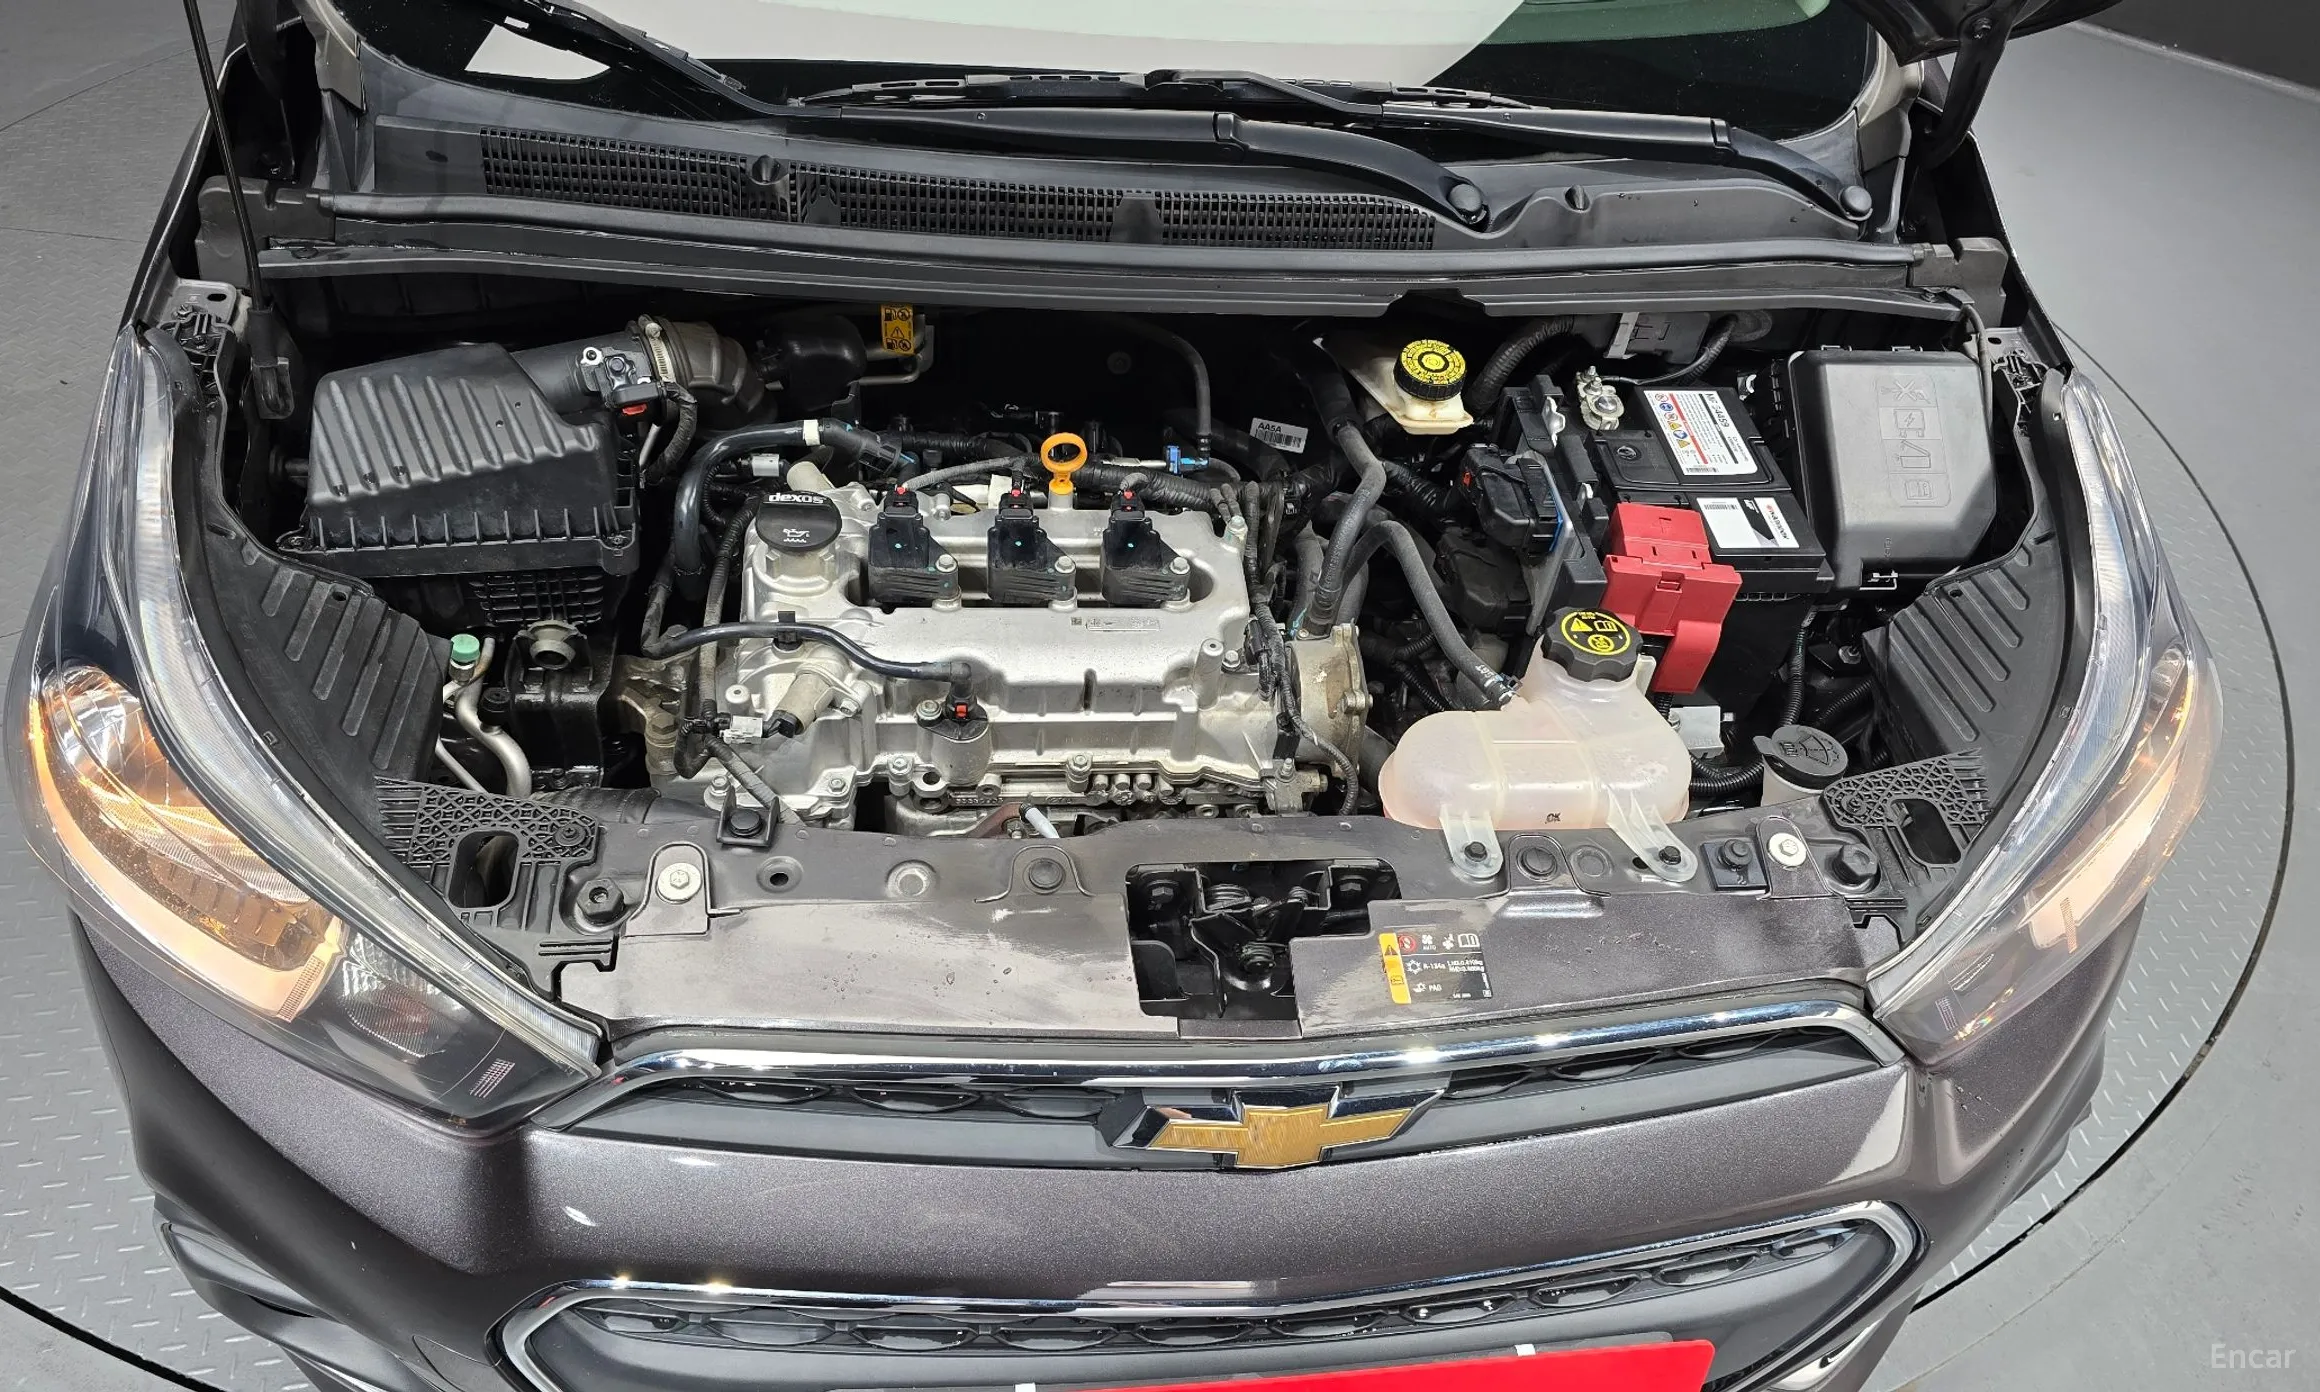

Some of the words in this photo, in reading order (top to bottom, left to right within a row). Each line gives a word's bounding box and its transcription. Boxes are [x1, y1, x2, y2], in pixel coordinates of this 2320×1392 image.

[768, 492, 826, 504] dexos
[1546, 812, 1561, 823] OK
[1428, 984, 1442, 992] PAG
